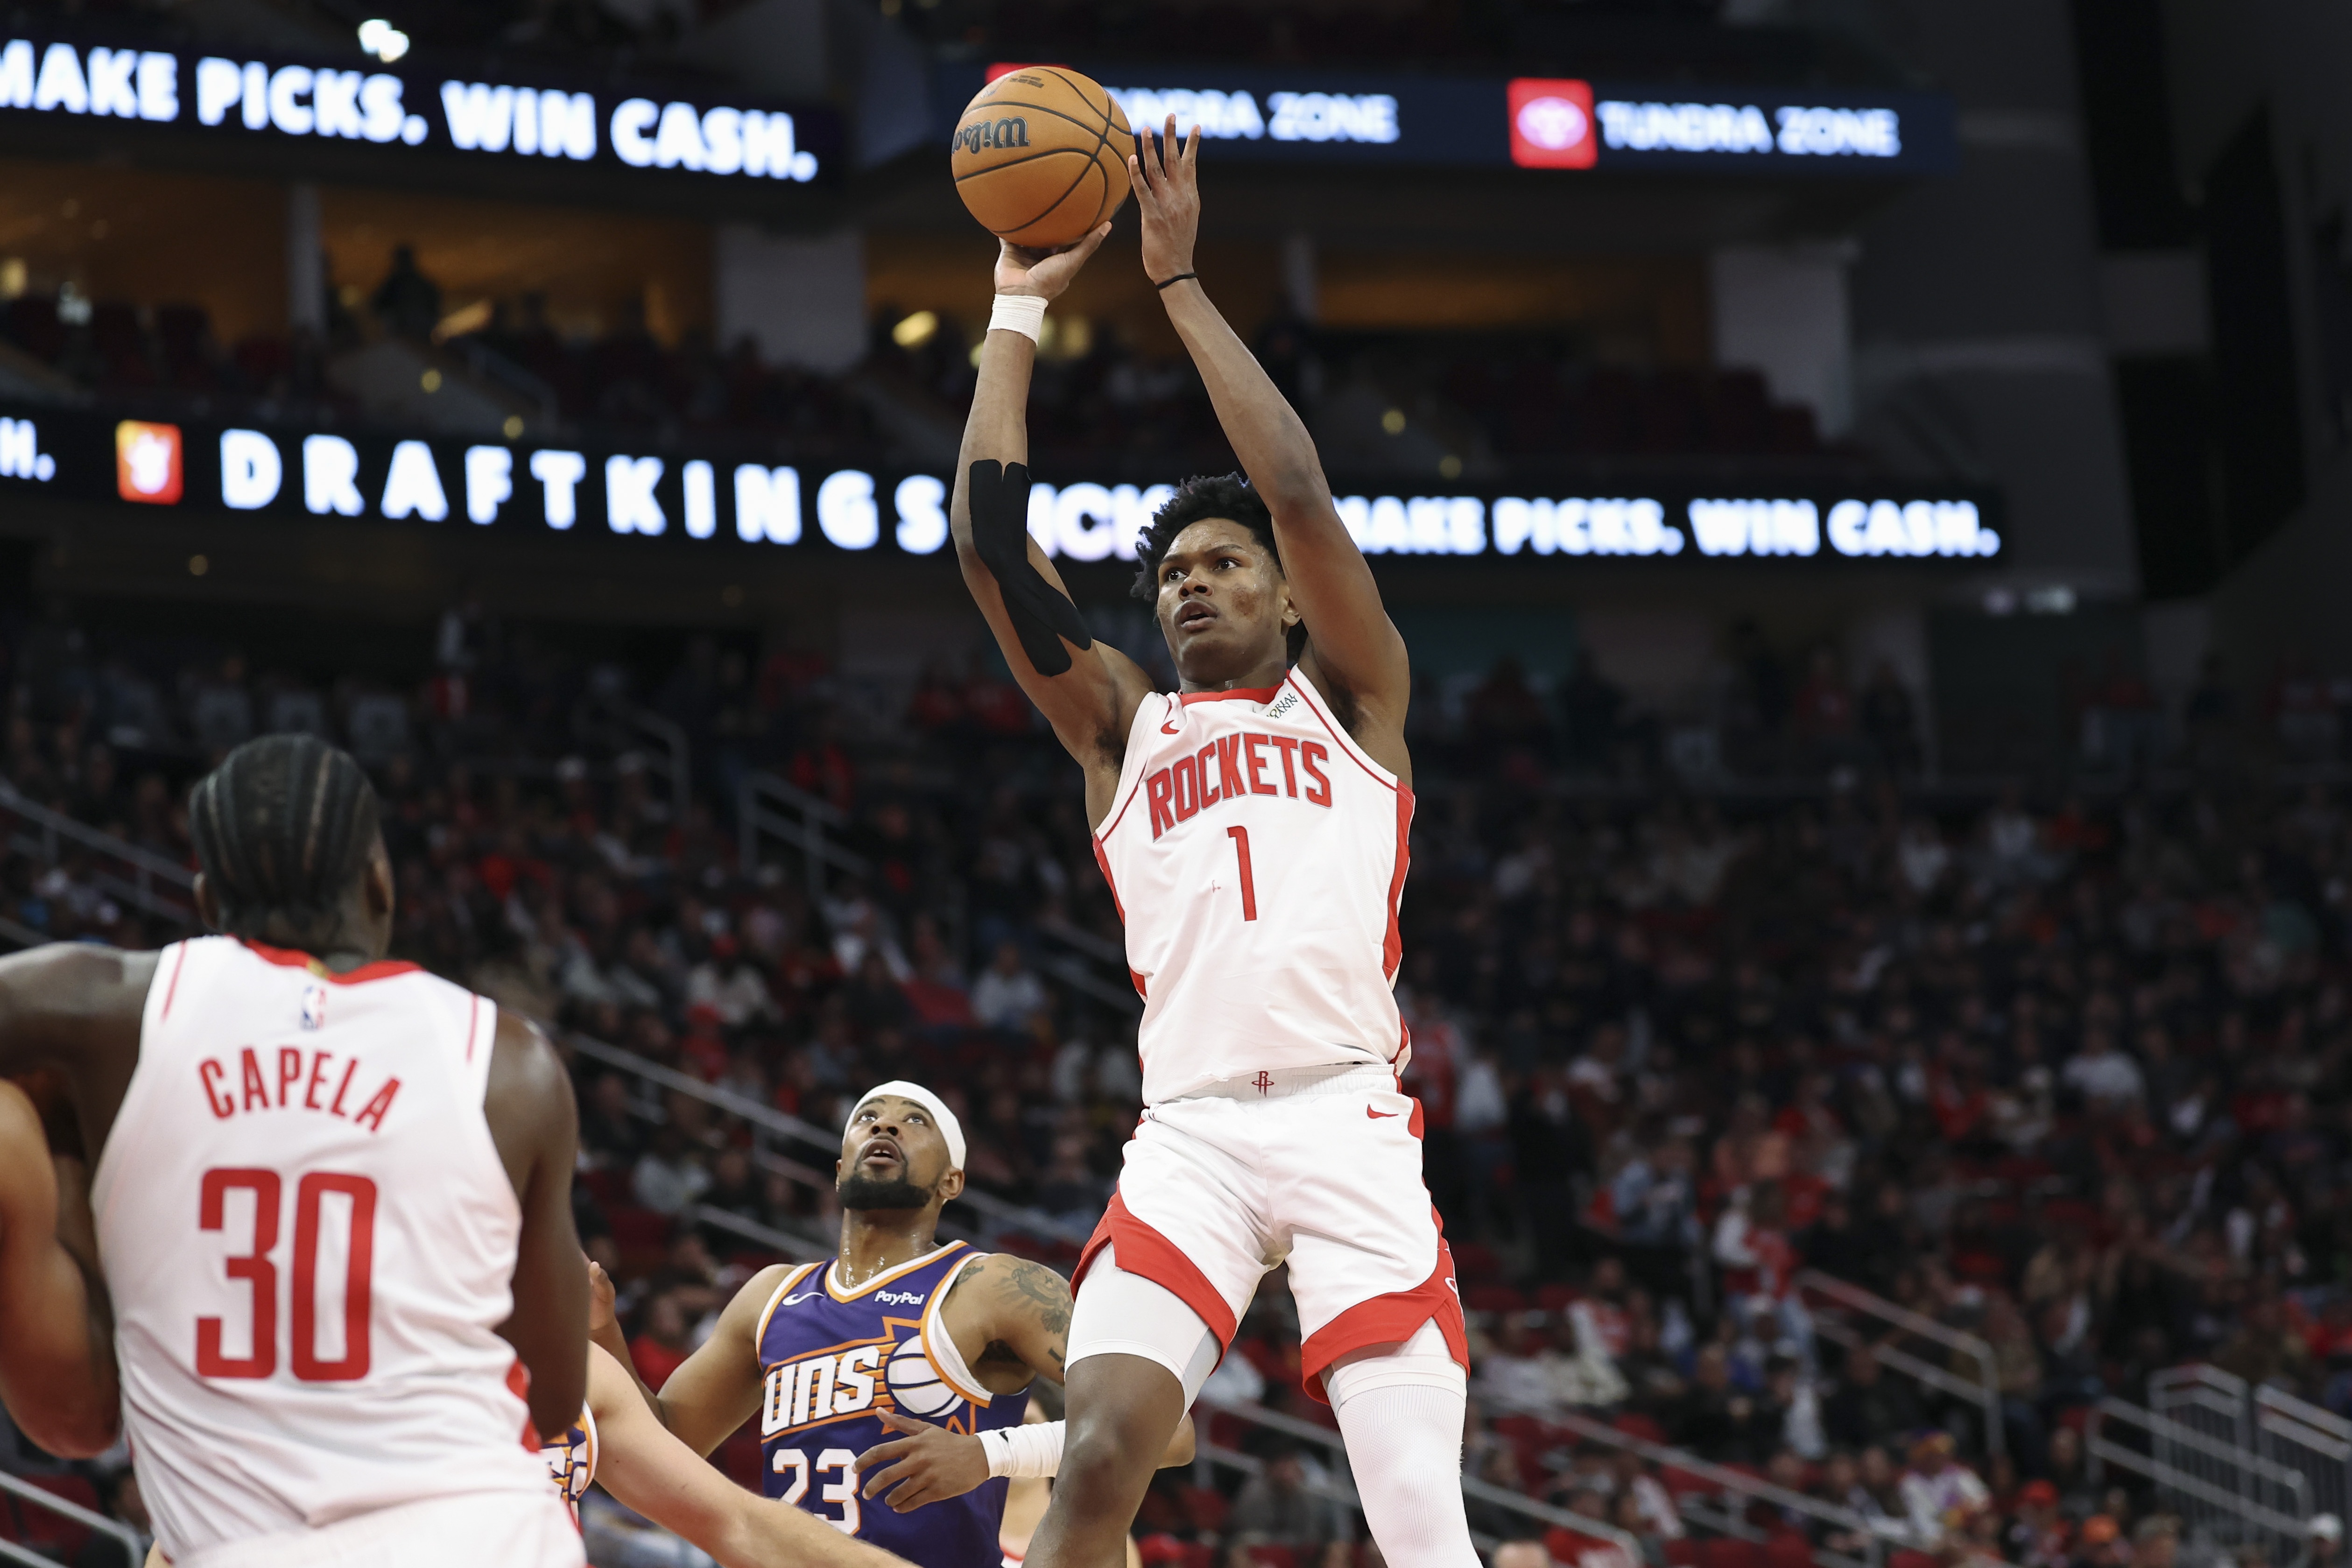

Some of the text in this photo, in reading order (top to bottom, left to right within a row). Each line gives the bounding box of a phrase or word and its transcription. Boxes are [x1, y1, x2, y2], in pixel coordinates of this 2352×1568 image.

[196, 56, 429, 146] PICKS.
[440, 80, 597, 160] WIN
[610, 98, 818, 182] CASH.
[951, 116, 1030, 156] Wilso
[1267, 91, 1400, 143] ZONE
[1596, 100, 1901, 157] TUNDRA ZONE
[220, 429, 949, 555] DRAFTKINGS
[1026, 482, 1179, 562] ICK
[1492, 497, 1684, 555] PICKS.
[1688, 498, 1820, 556] WIN
[1827, 499, 2000, 557] CASH.
[1267, 693, 1295, 717] ORIAL
[1146, 731, 1333, 843] ROCKETS
[1227, 826, 1257, 921] 1
[199, 1048, 401, 1132] CAPELA
[197, 1167, 377, 1382] 30
[874, 1290, 925, 1306] PayPal
[761, 1345, 880, 1436] UNS
[773, 1448, 861, 1535] 23
